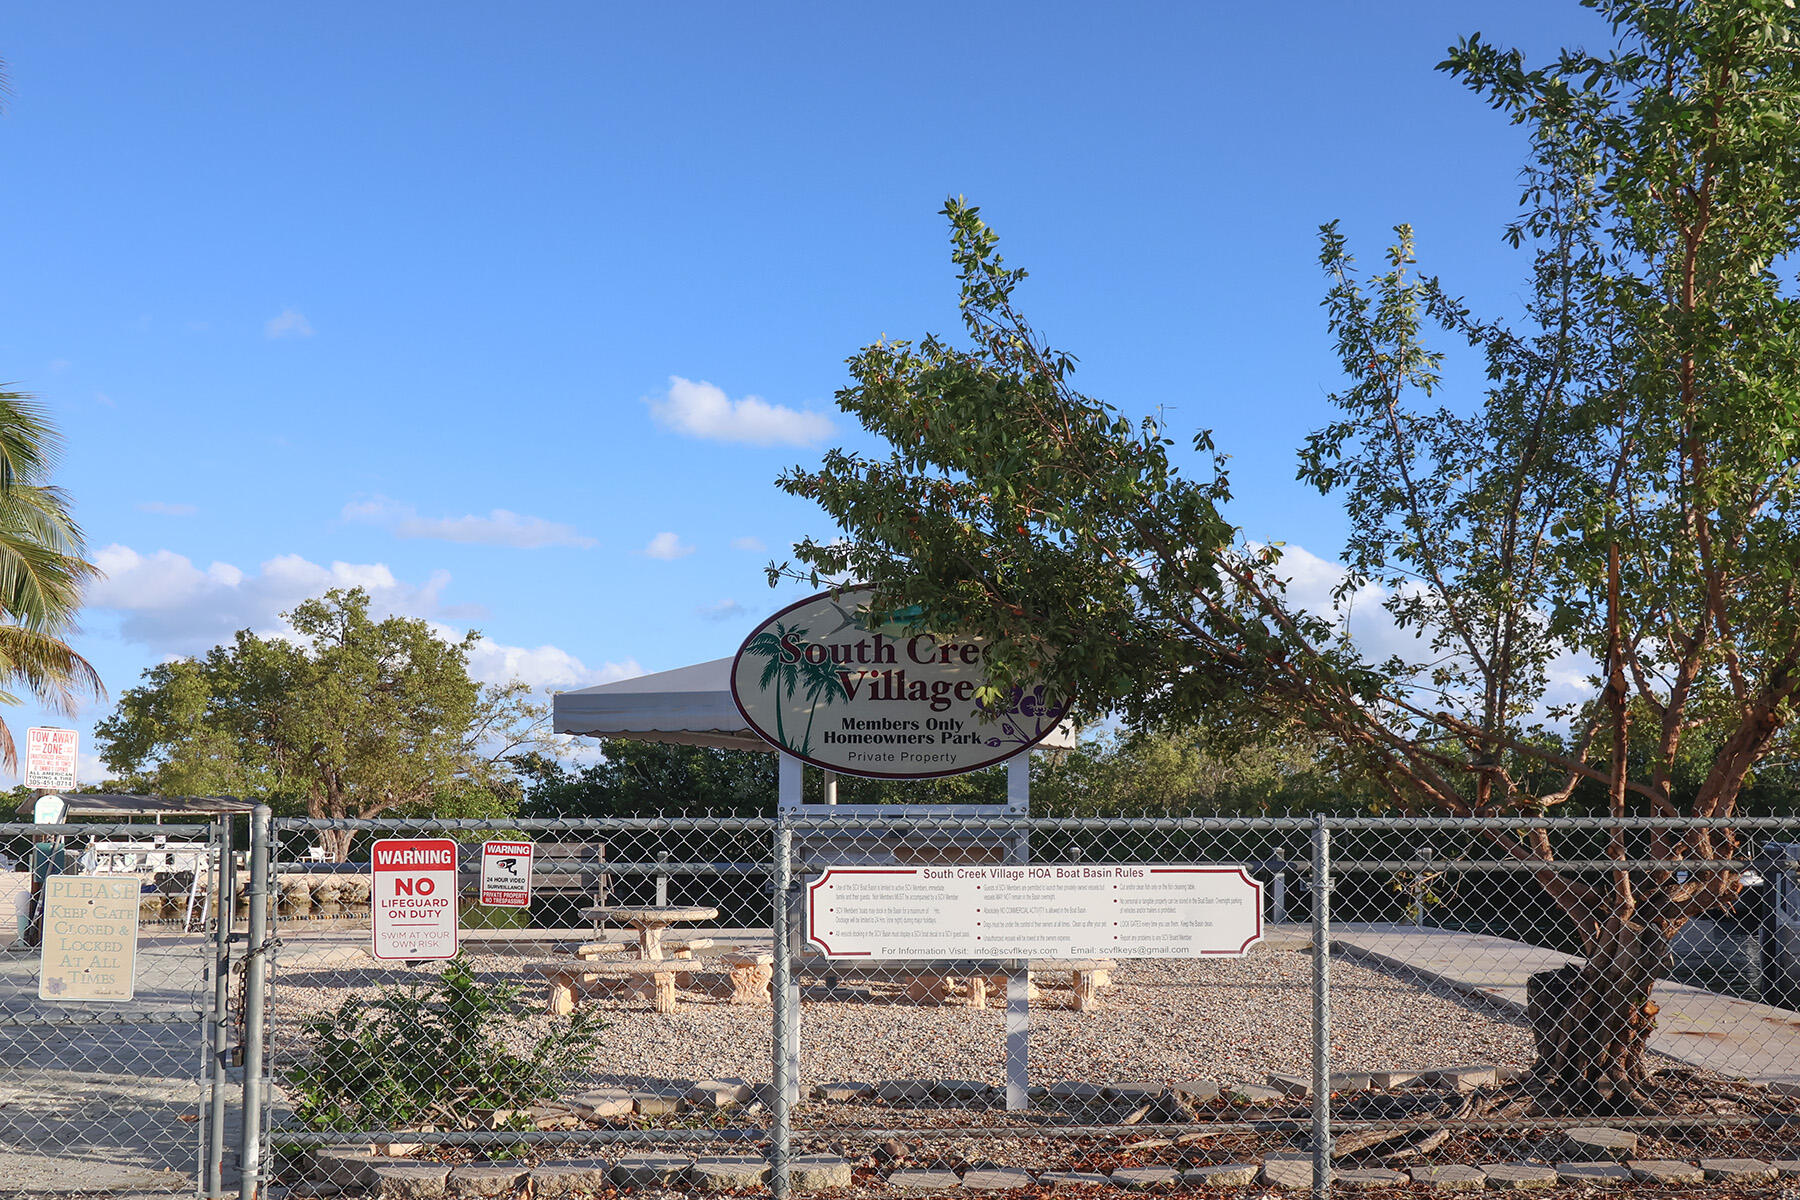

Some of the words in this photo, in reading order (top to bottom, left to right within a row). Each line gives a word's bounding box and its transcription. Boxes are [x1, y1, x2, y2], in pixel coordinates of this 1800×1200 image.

[779, 633, 897, 665] South
[836, 669, 975, 712] Village
[841, 717, 919, 731] Members
[926, 717, 964, 733] Only
[32, 731, 50, 742] TOW
[53, 732, 74, 744] AWAY
[823, 731, 935, 745] Homeowners
[941, 731, 982, 745] Park
[42, 743, 63, 754] ZONE
[848, 752, 895, 762] Private
[900, 752, 957, 764] Property
[487, 844, 530, 855] WARNING
[378, 850, 451, 865] WARNING
[923, 868, 954, 879] South
[957, 868, 987, 879] Creek
[990, 868, 1025, 881] Village
[1028, 868, 1051, 878] HOA
[1056, 868, 1080, 878] Boat
[1083, 868, 1112, 878] Basin
[1115, 867, 1144, 878] Rules
[52, 882, 136, 899] PLEASE
[395, 877, 435, 896] NO
[381, 898, 449, 908] LIFEGUARD
[388, 910, 406, 919] ON
[410, 909, 442, 918] DUTY
[119, 924, 129, 935] &
[381, 932, 407, 940] SWIM
[409, 931, 421, 939] AT
[423, 931, 450, 939] YOUR
[418, 940, 440, 948] RISK
[881, 946, 897, 955] For
[898, 946, 946, 955] Information
[948, 946, 969, 955] Visit:
[1070, 946, 1097, 955] Email:
